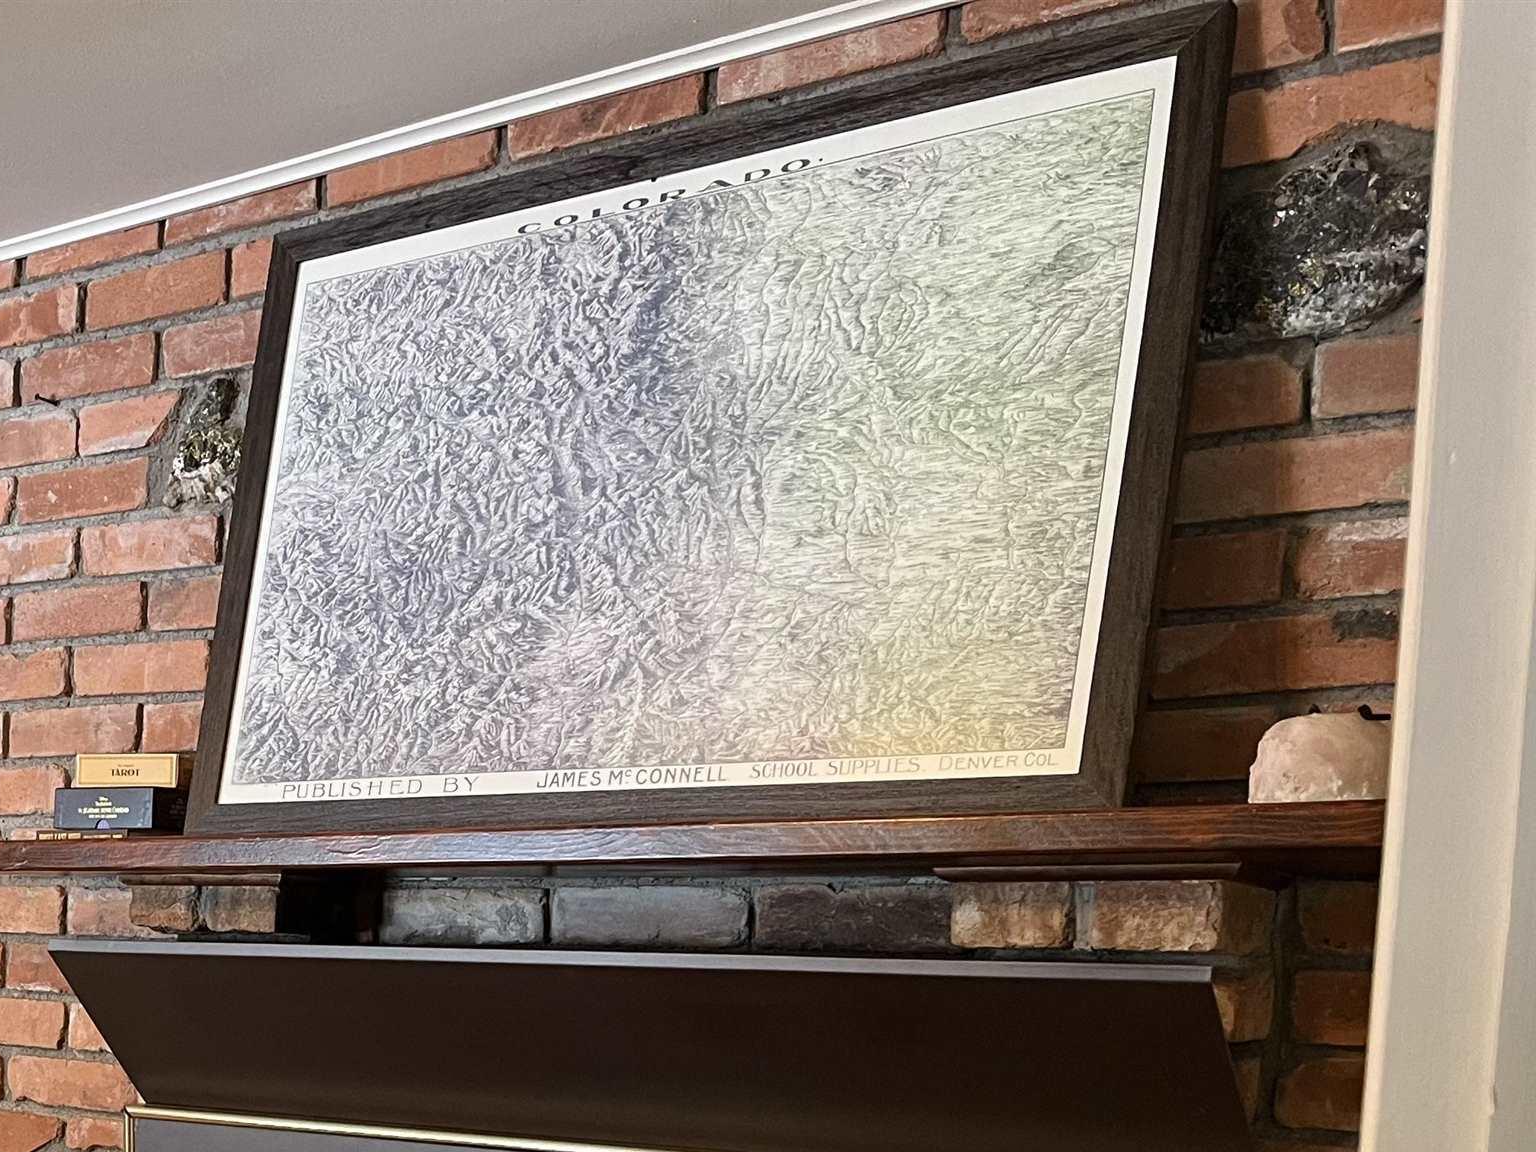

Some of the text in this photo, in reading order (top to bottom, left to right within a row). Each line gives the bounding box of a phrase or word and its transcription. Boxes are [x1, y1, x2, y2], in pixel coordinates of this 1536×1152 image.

[110, 768, 140, 777] TAROT
[282, 778, 423, 799] PUBLISHED
[442, 776, 480, 794] BY
[536, 770, 602, 789] JAMES
[749, 760, 817, 780] SCHOOL
[938, 754, 1017, 772] DENVER
